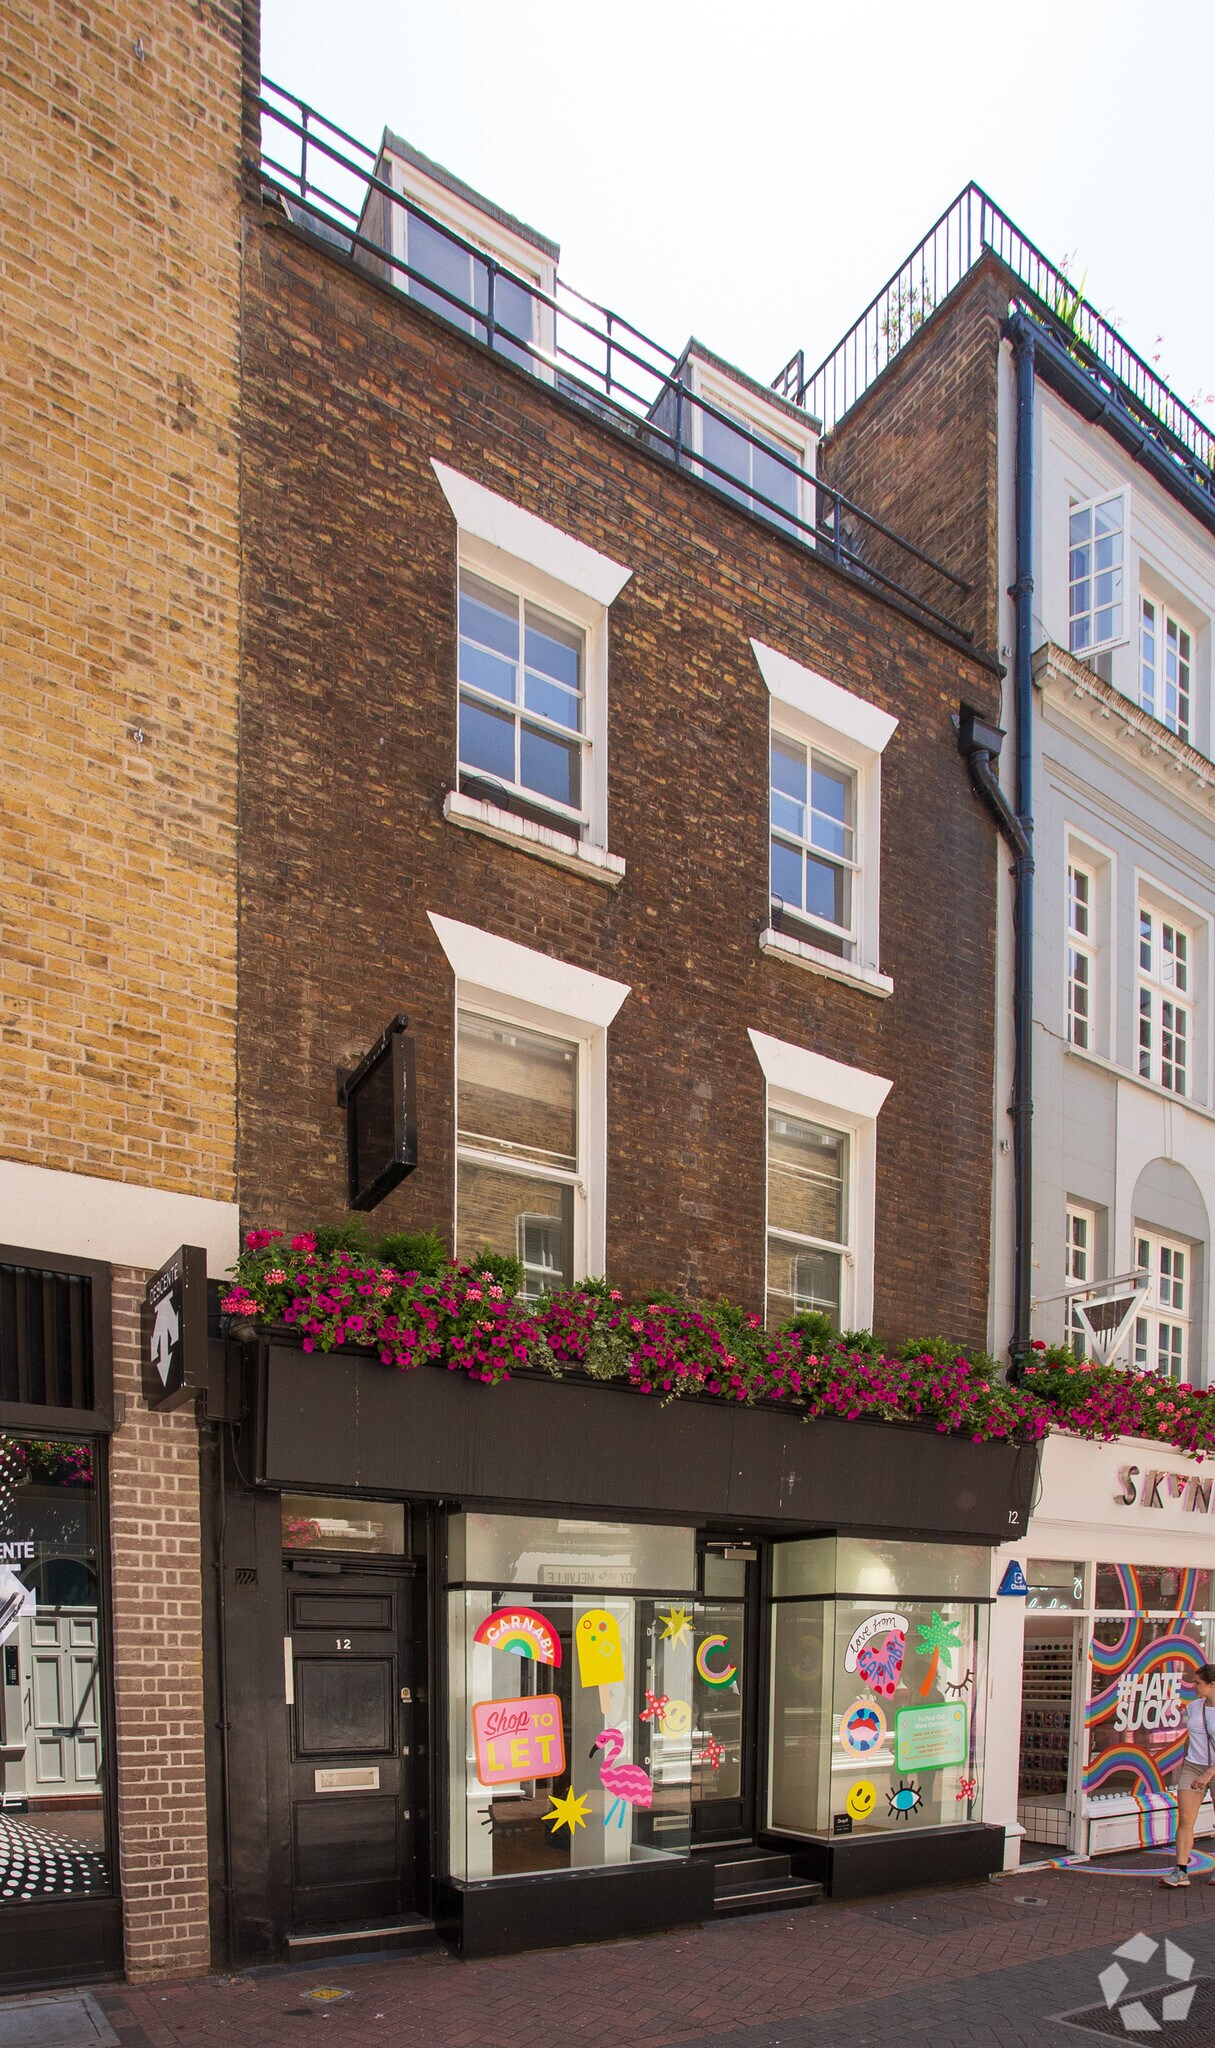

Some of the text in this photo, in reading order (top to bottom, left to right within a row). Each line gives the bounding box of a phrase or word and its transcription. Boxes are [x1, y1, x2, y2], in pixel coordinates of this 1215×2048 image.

[150, 1262, 178, 1305] DESCENTE
[486, 1615, 554, 1660] CARNABY
[873, 1617, 897, 1633] from
[336, 1639, 352, 1650] 12
[859, 1636, 904, 1684] CARNABY
[1116, 1672, 1183, 1703] #HATE
[484, 1708, 554, 1735] Shop TO
[1113, 1698, 1182, 1732] SUCKS
[487, 1734, 556, 1772] LET
